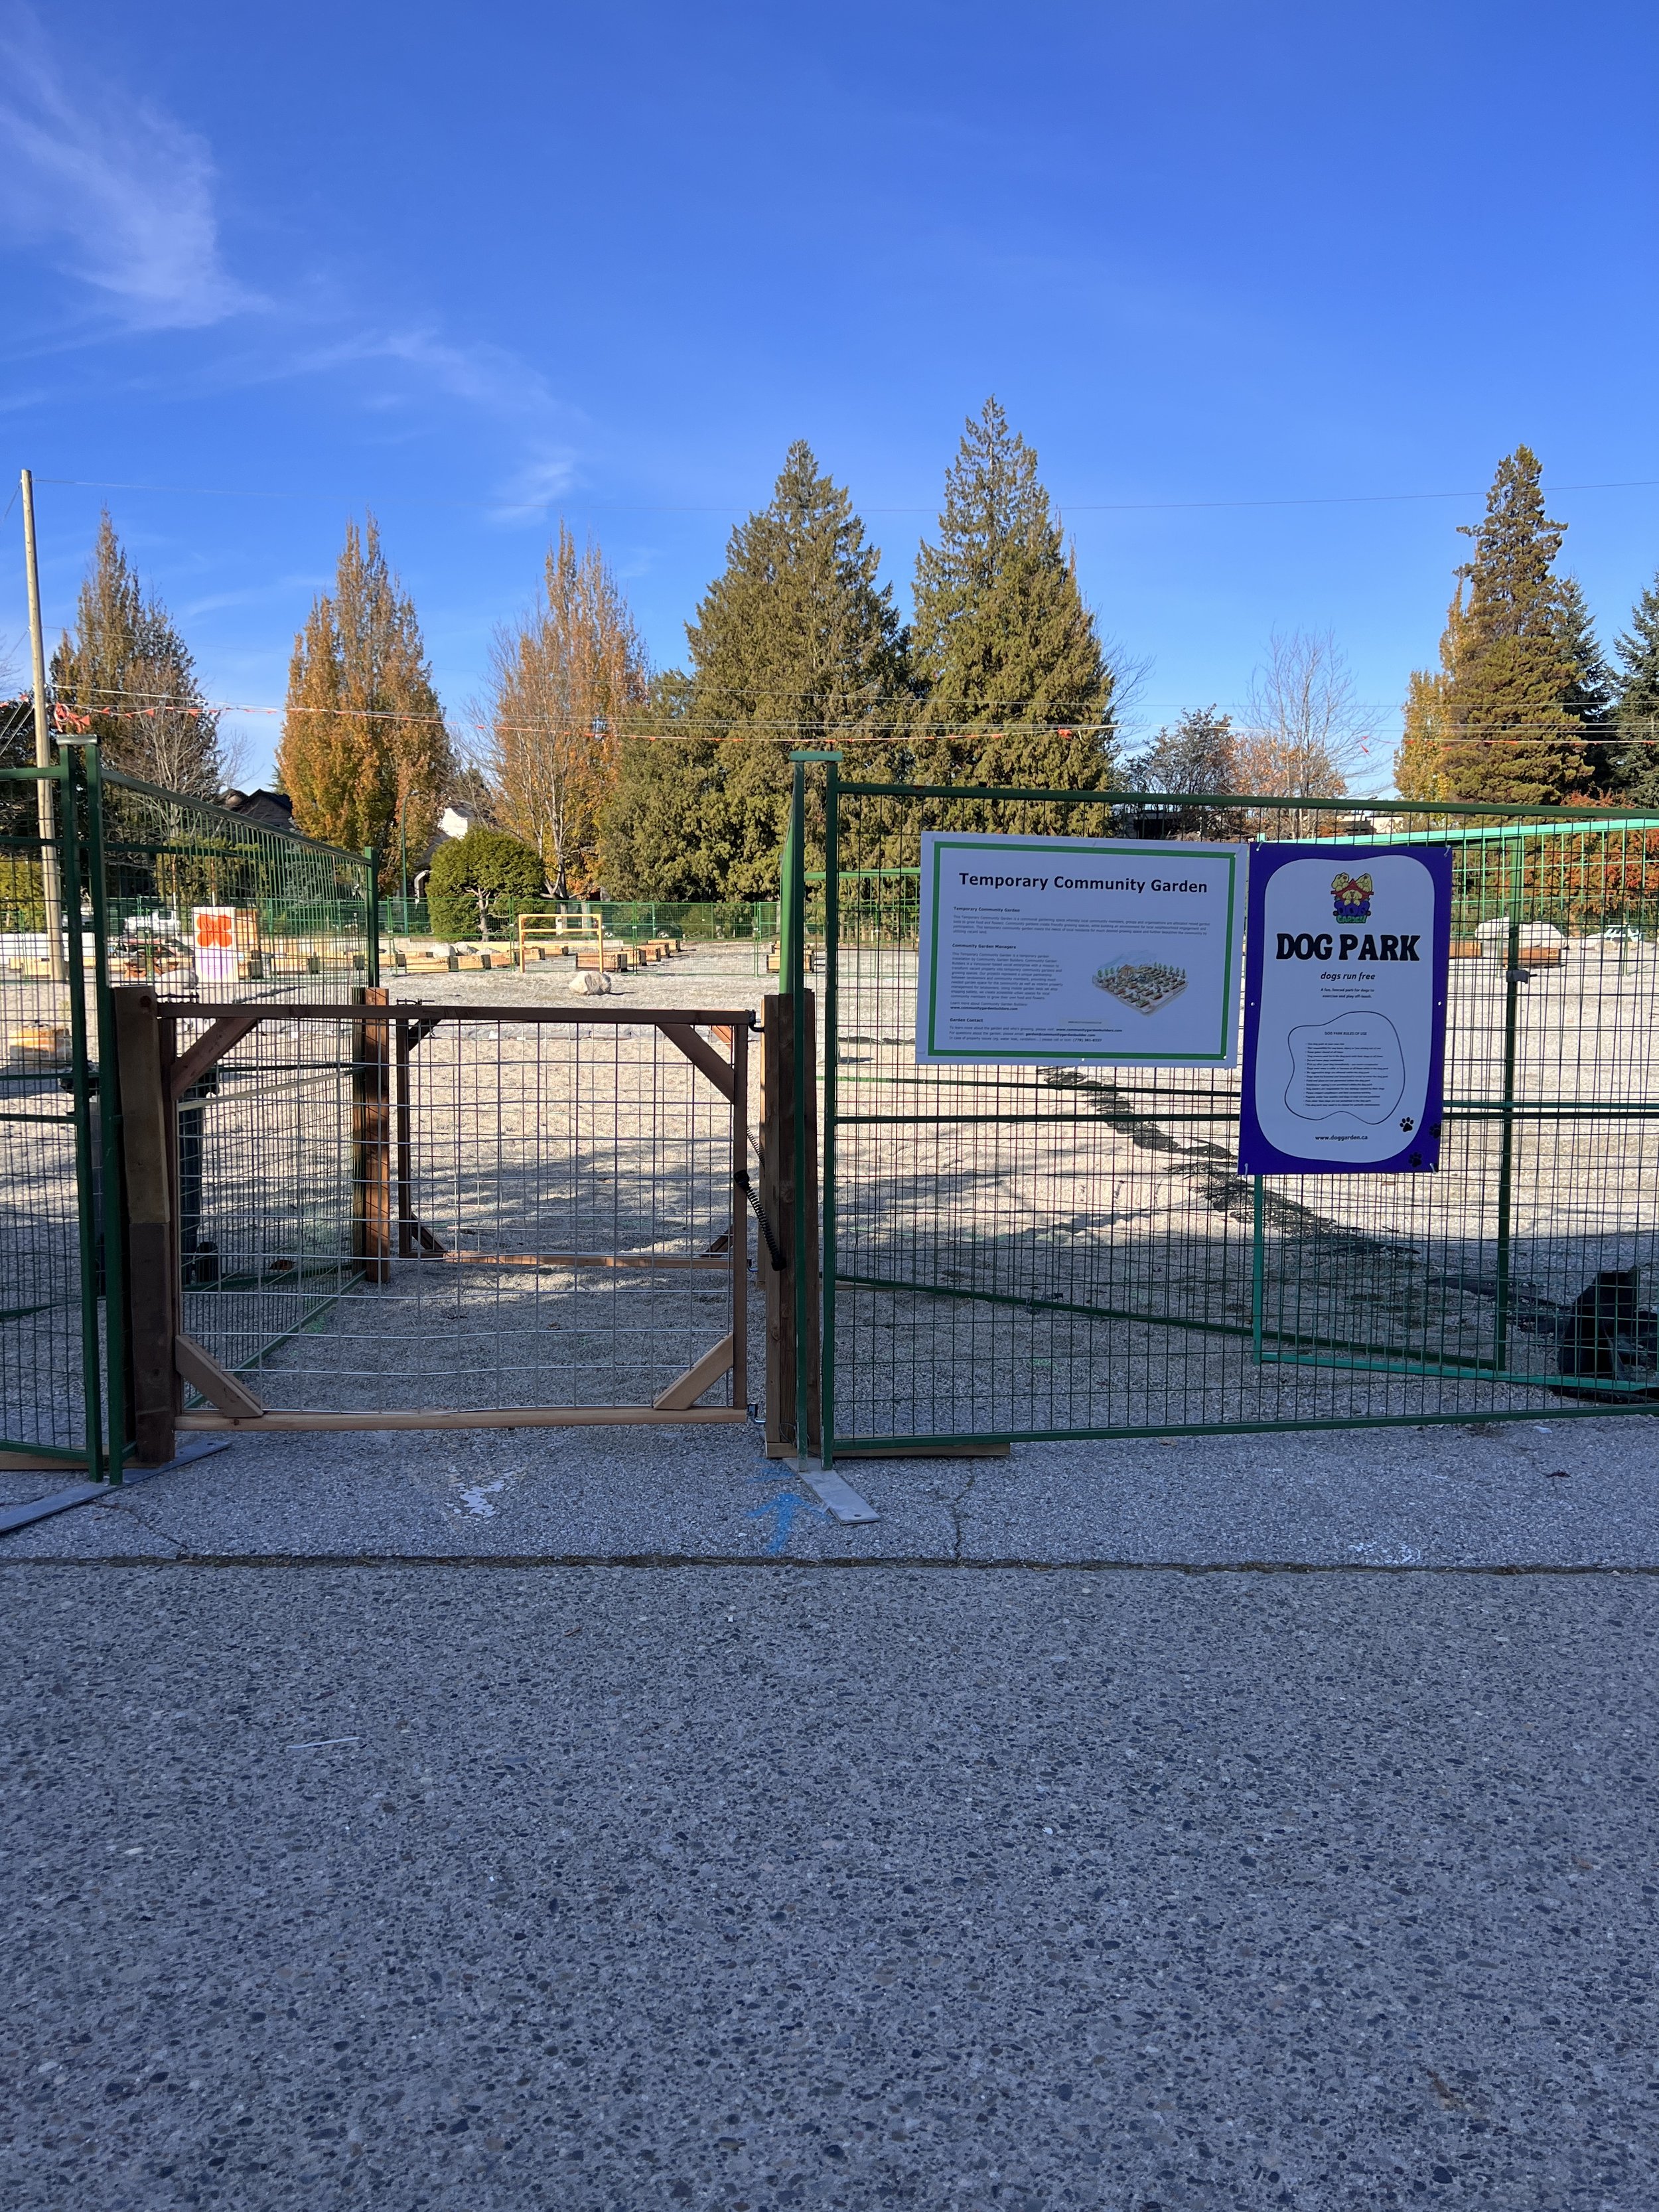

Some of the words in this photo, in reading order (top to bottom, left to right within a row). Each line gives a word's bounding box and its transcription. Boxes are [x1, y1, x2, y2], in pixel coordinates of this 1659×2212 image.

[959, 873, 1048, 891] Temporary
[1054, 876, 1145, 894] Community
[1151, 879, 1207, 893] Garden
[1276, 933, 1333, 960] DOG
[1339, 934, 1421, 961] PARK
[1321, 972, 1340, 981] dogs
[1358, 972, 1376, 981] free
